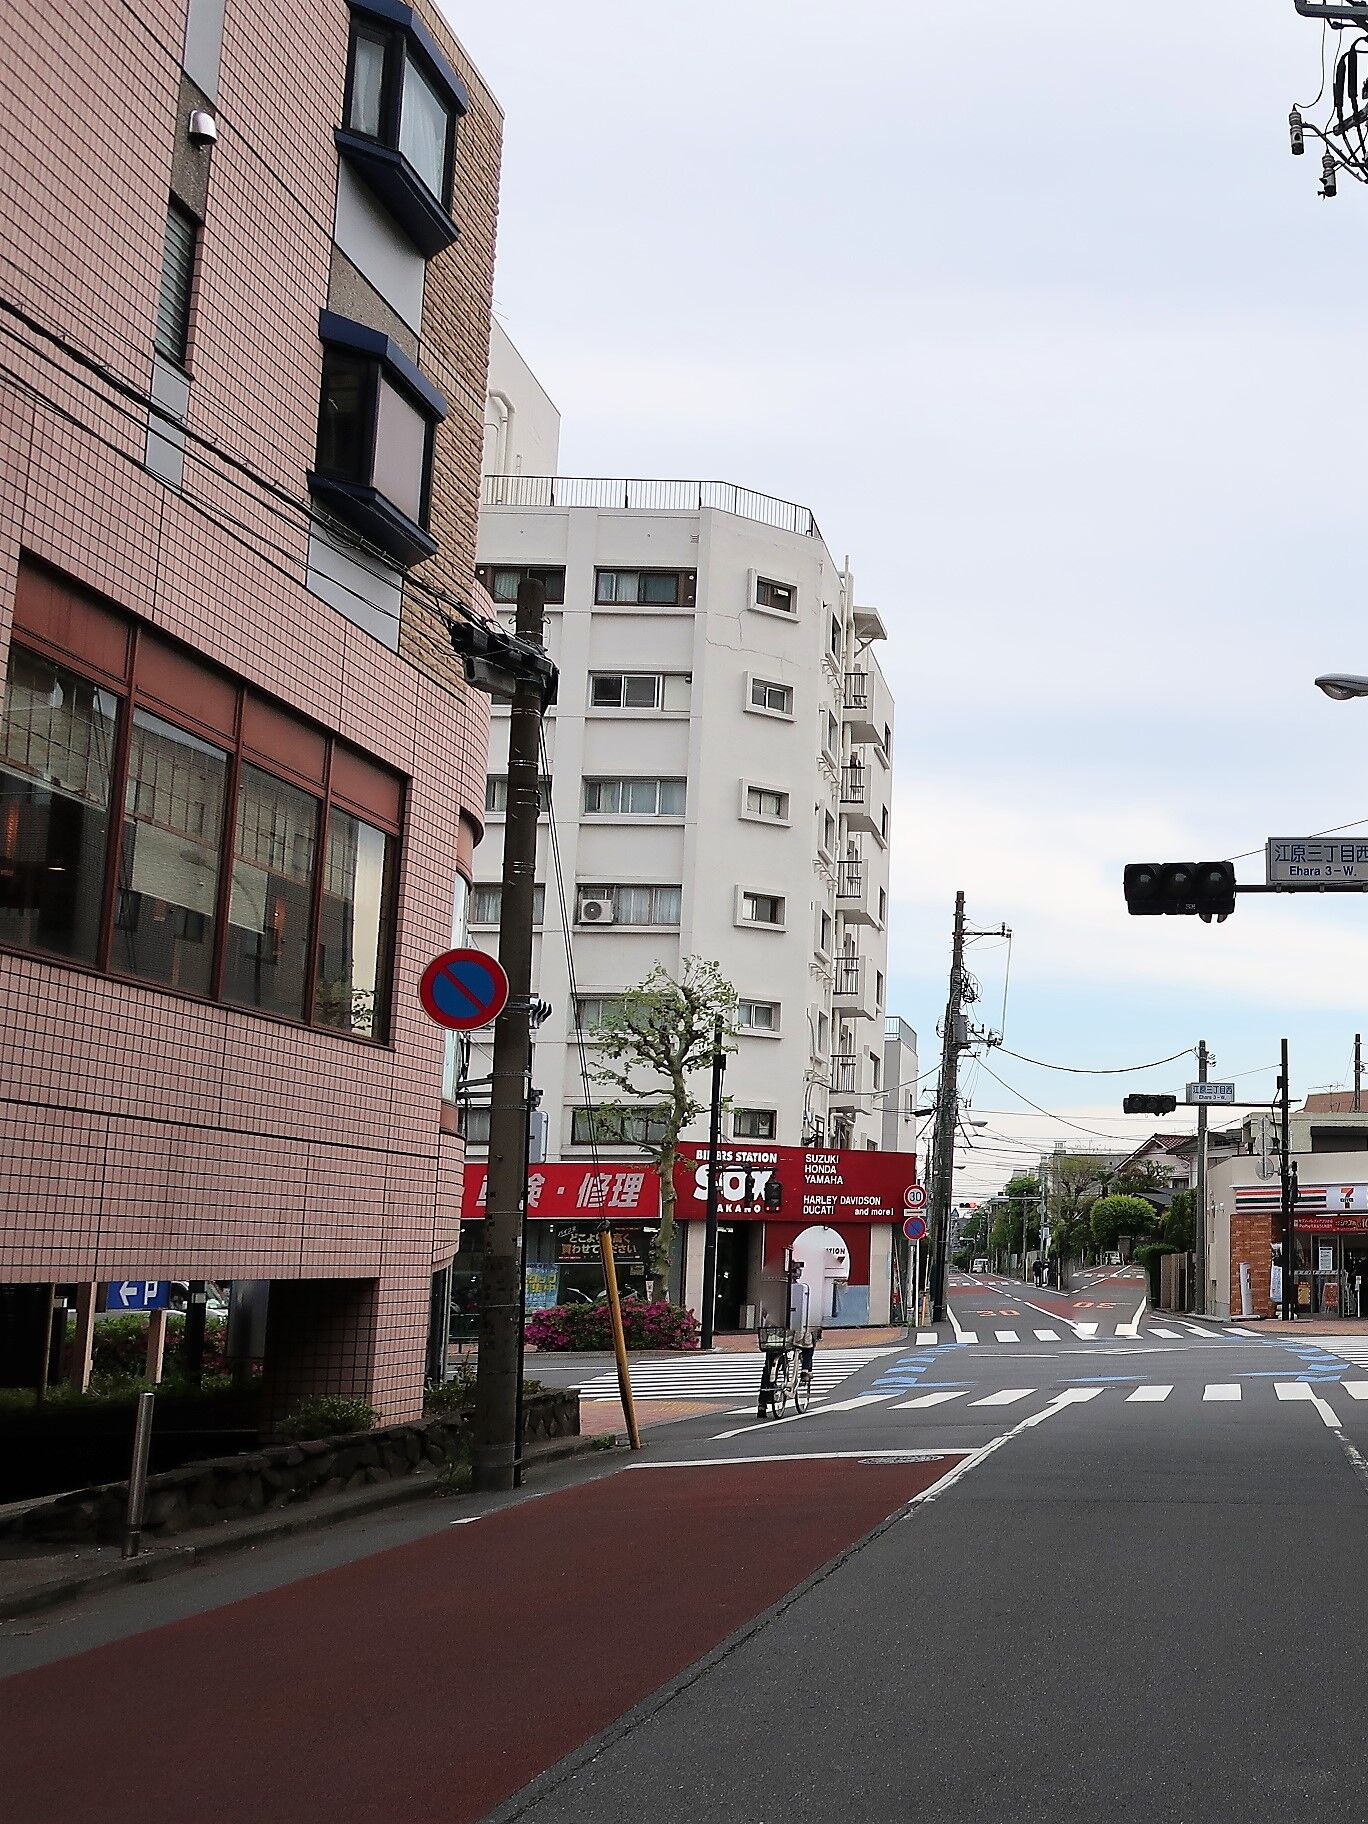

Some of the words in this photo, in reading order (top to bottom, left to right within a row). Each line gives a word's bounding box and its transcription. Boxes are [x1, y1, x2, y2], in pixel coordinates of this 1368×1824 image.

[1289, 866, 1320, 876] Ehara
[696, 1149, 733, 1161] BIERS
[735, 1151, 778, 1163] STATION
[805, 1153, 839, 1164] SUZUKI
[804, 1164, 837, 1174] HONDA
[804, 1174, 844, 1185] YAMAHA
[803, 1194, 838, 1205] HARLEY
[840, 1196, 881, 1206] DAVIDSON
[909, 1191, 921, 1202] 30
[802, 1205, 835, 1215] DUCATI
[854, 1207, 869, 1216] and
[871, 1207, 894, 1216] more!
[143, 1281, 158, 1305] P
